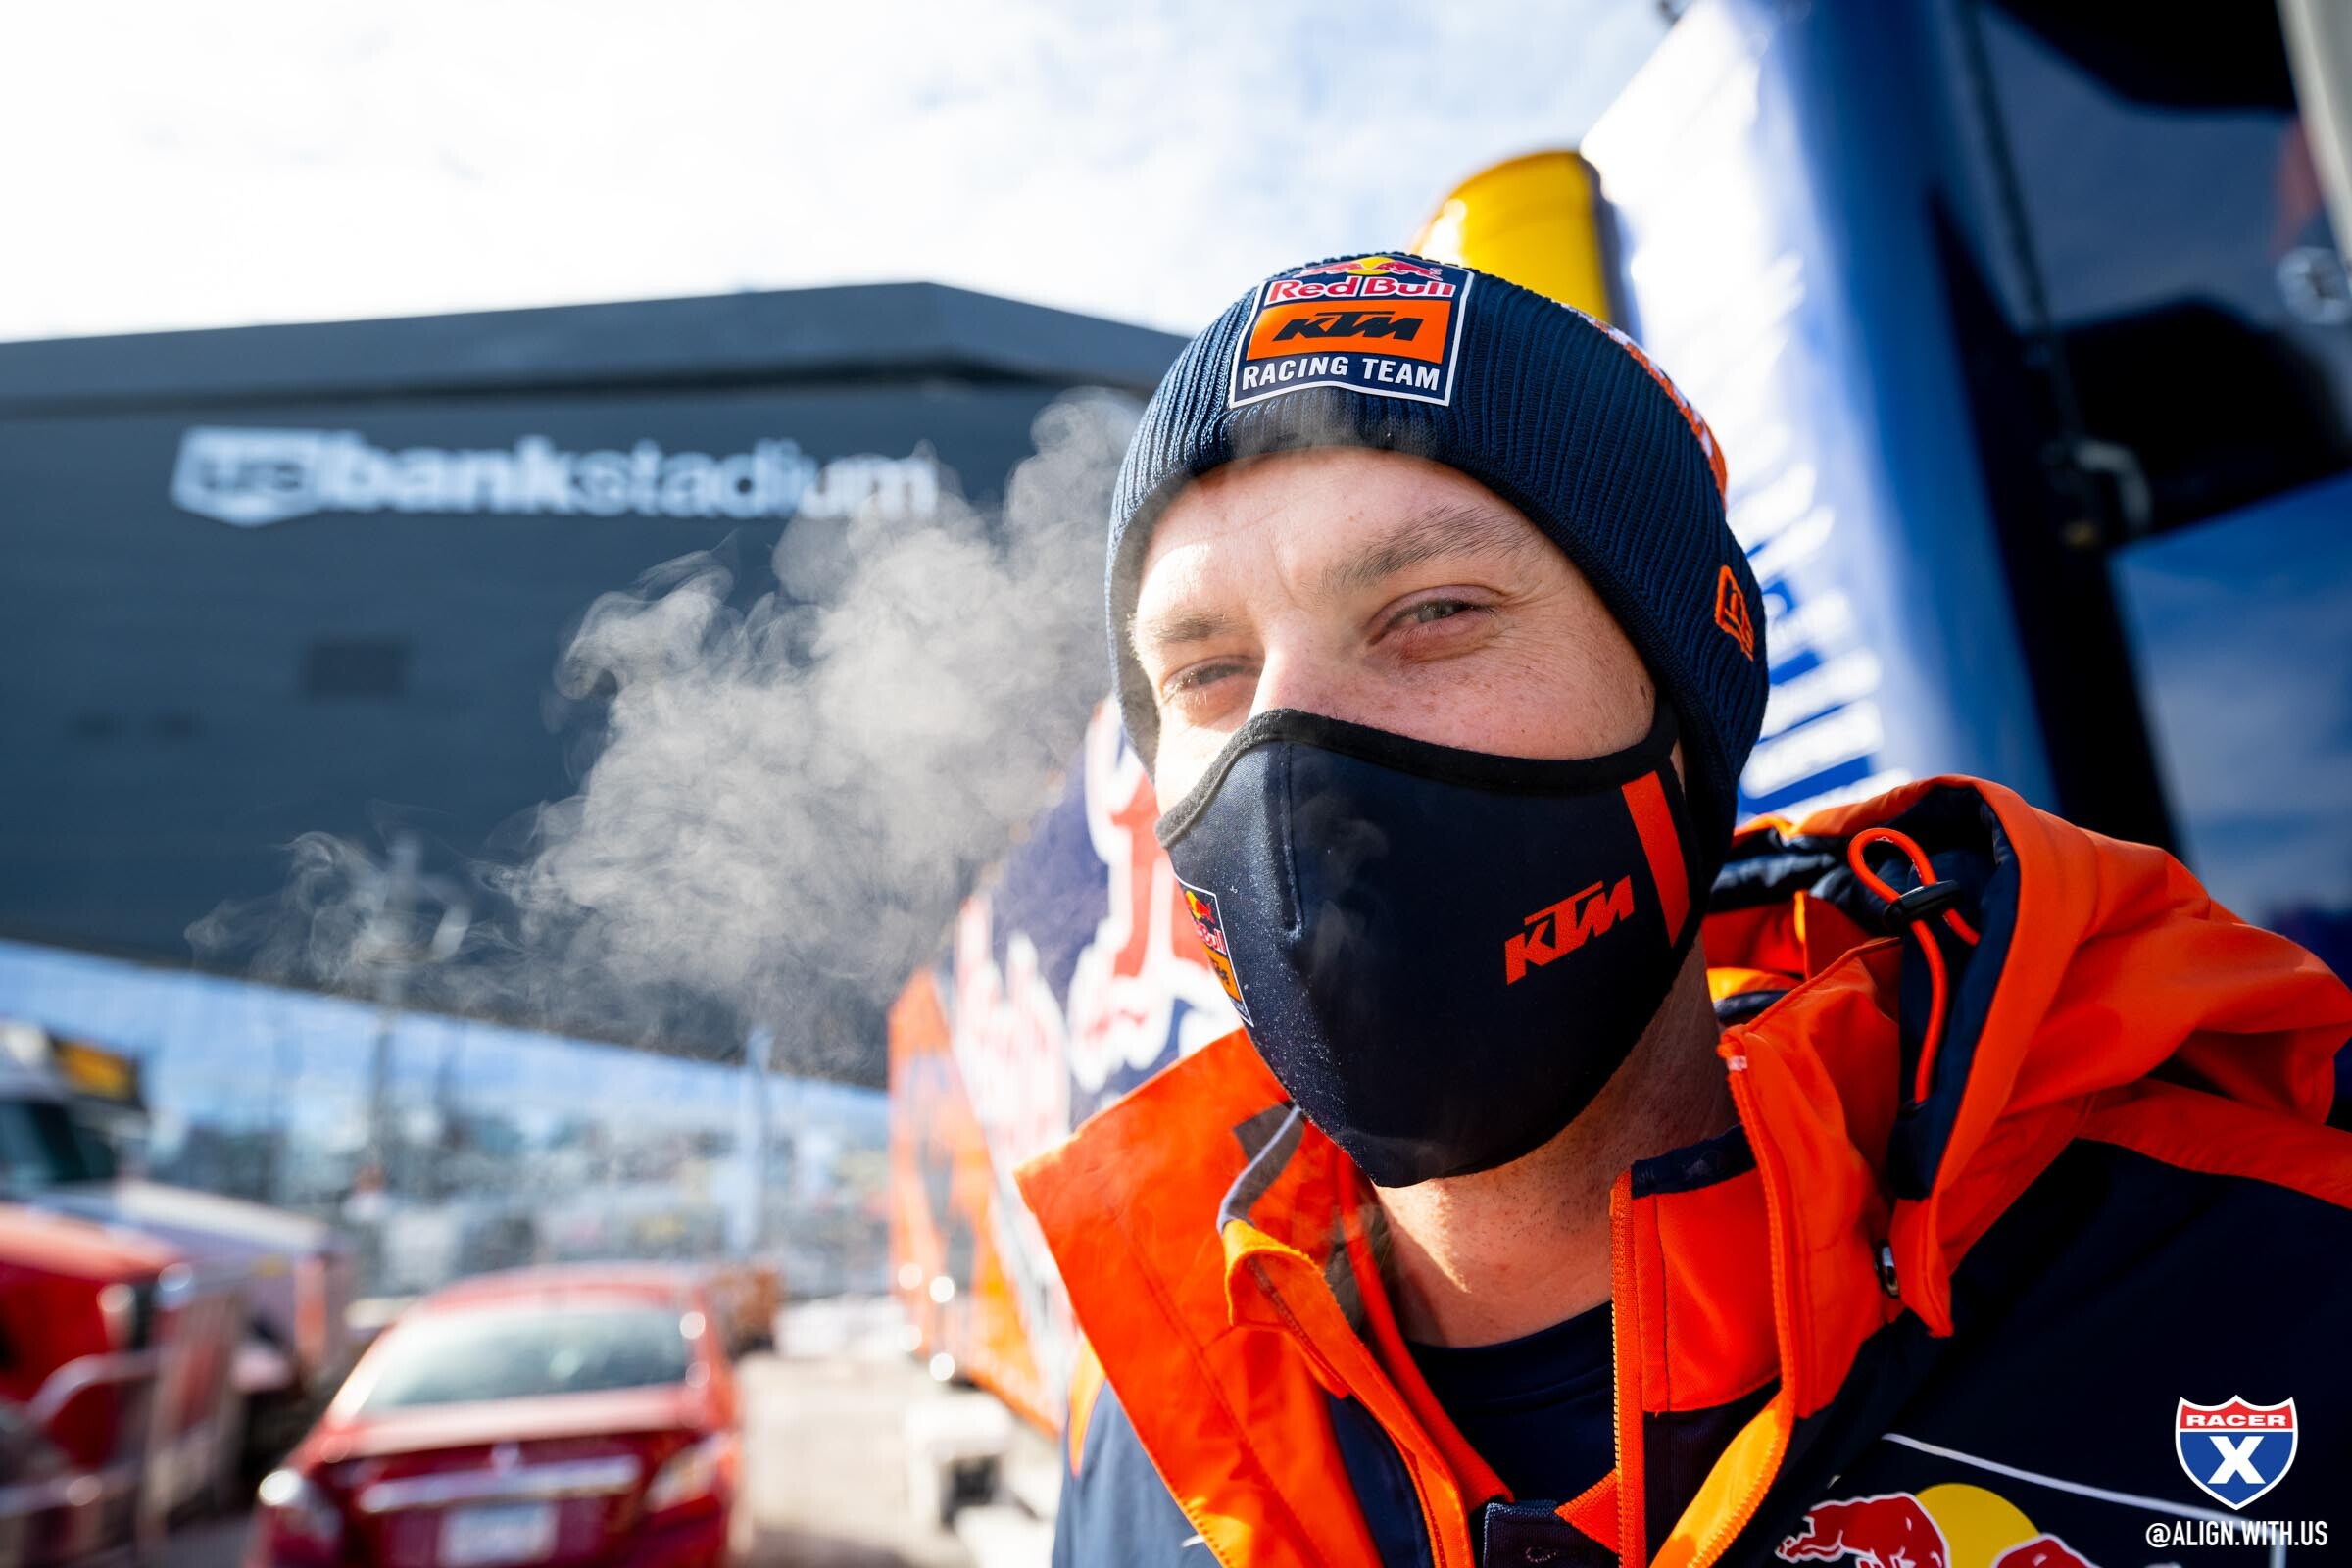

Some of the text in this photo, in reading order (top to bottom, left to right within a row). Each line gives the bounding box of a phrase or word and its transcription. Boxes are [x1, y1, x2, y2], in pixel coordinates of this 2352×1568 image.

[1265, 276, 1456, 306] Red Bull
[1272, 310, 1425, 343] KTM
[1241, 356, 1442, 392] RACING TEAM
[1504, 874, 1635, 986] KTM
